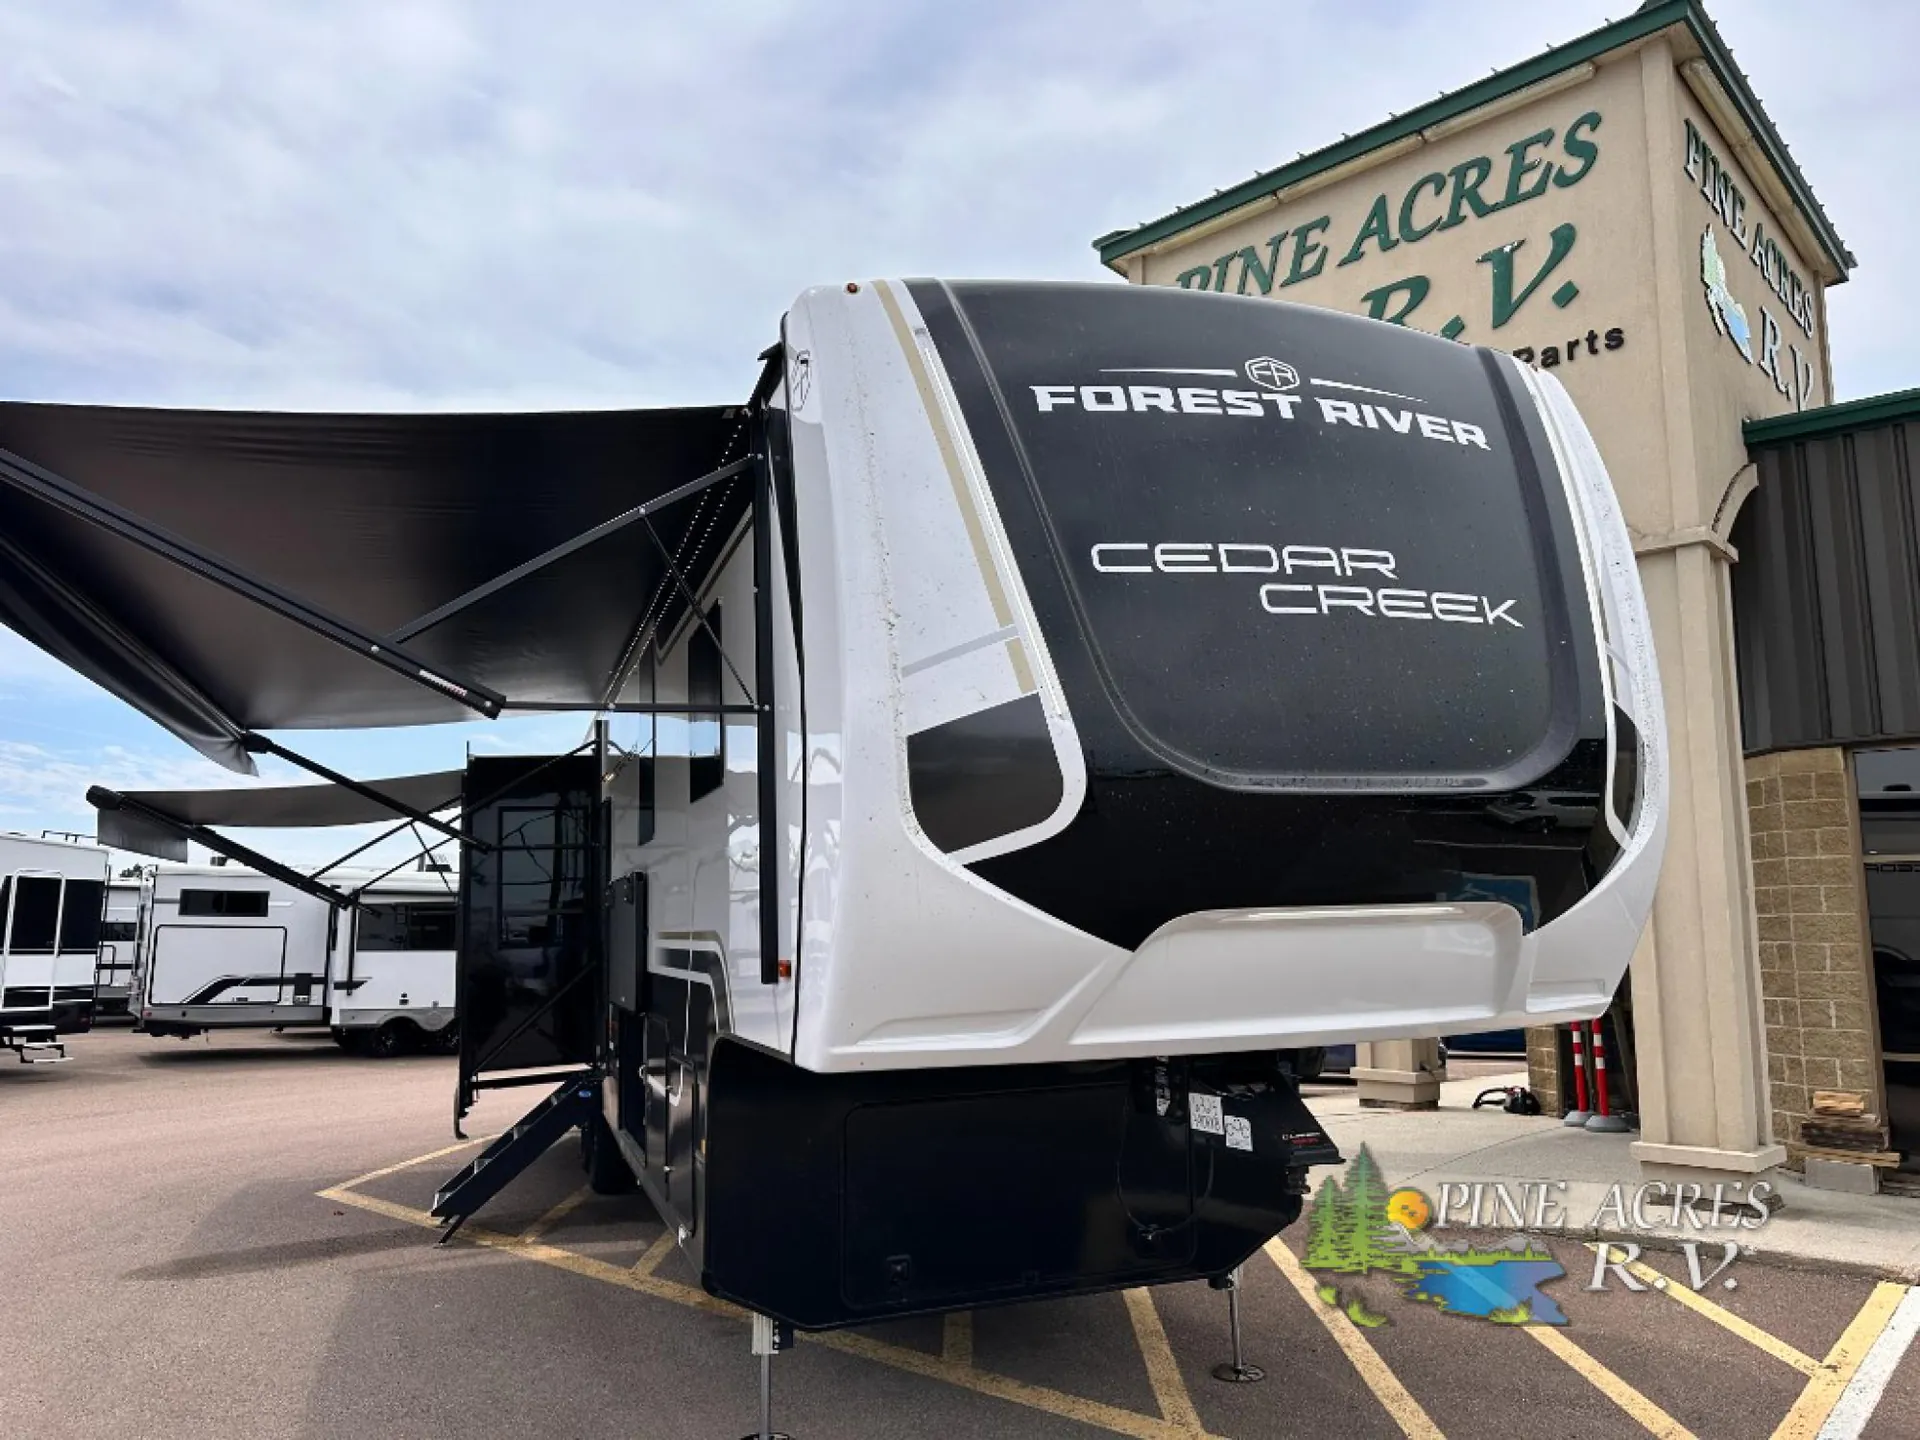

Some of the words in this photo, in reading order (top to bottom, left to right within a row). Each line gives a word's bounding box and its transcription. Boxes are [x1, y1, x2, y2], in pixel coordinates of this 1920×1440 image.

[1338, 111, 1603, 267] ACRES
[1684, 118, 1748, 250] PINE
[1749, 222, 1814, 339] ACRES
[1029, 385, 1302, 420] FOREST
[1313, 396, 1492, 450] RIVER
[1091, 543, 1399, 579] CEDAR
[1259, 584, 1524, 628] CREEK
